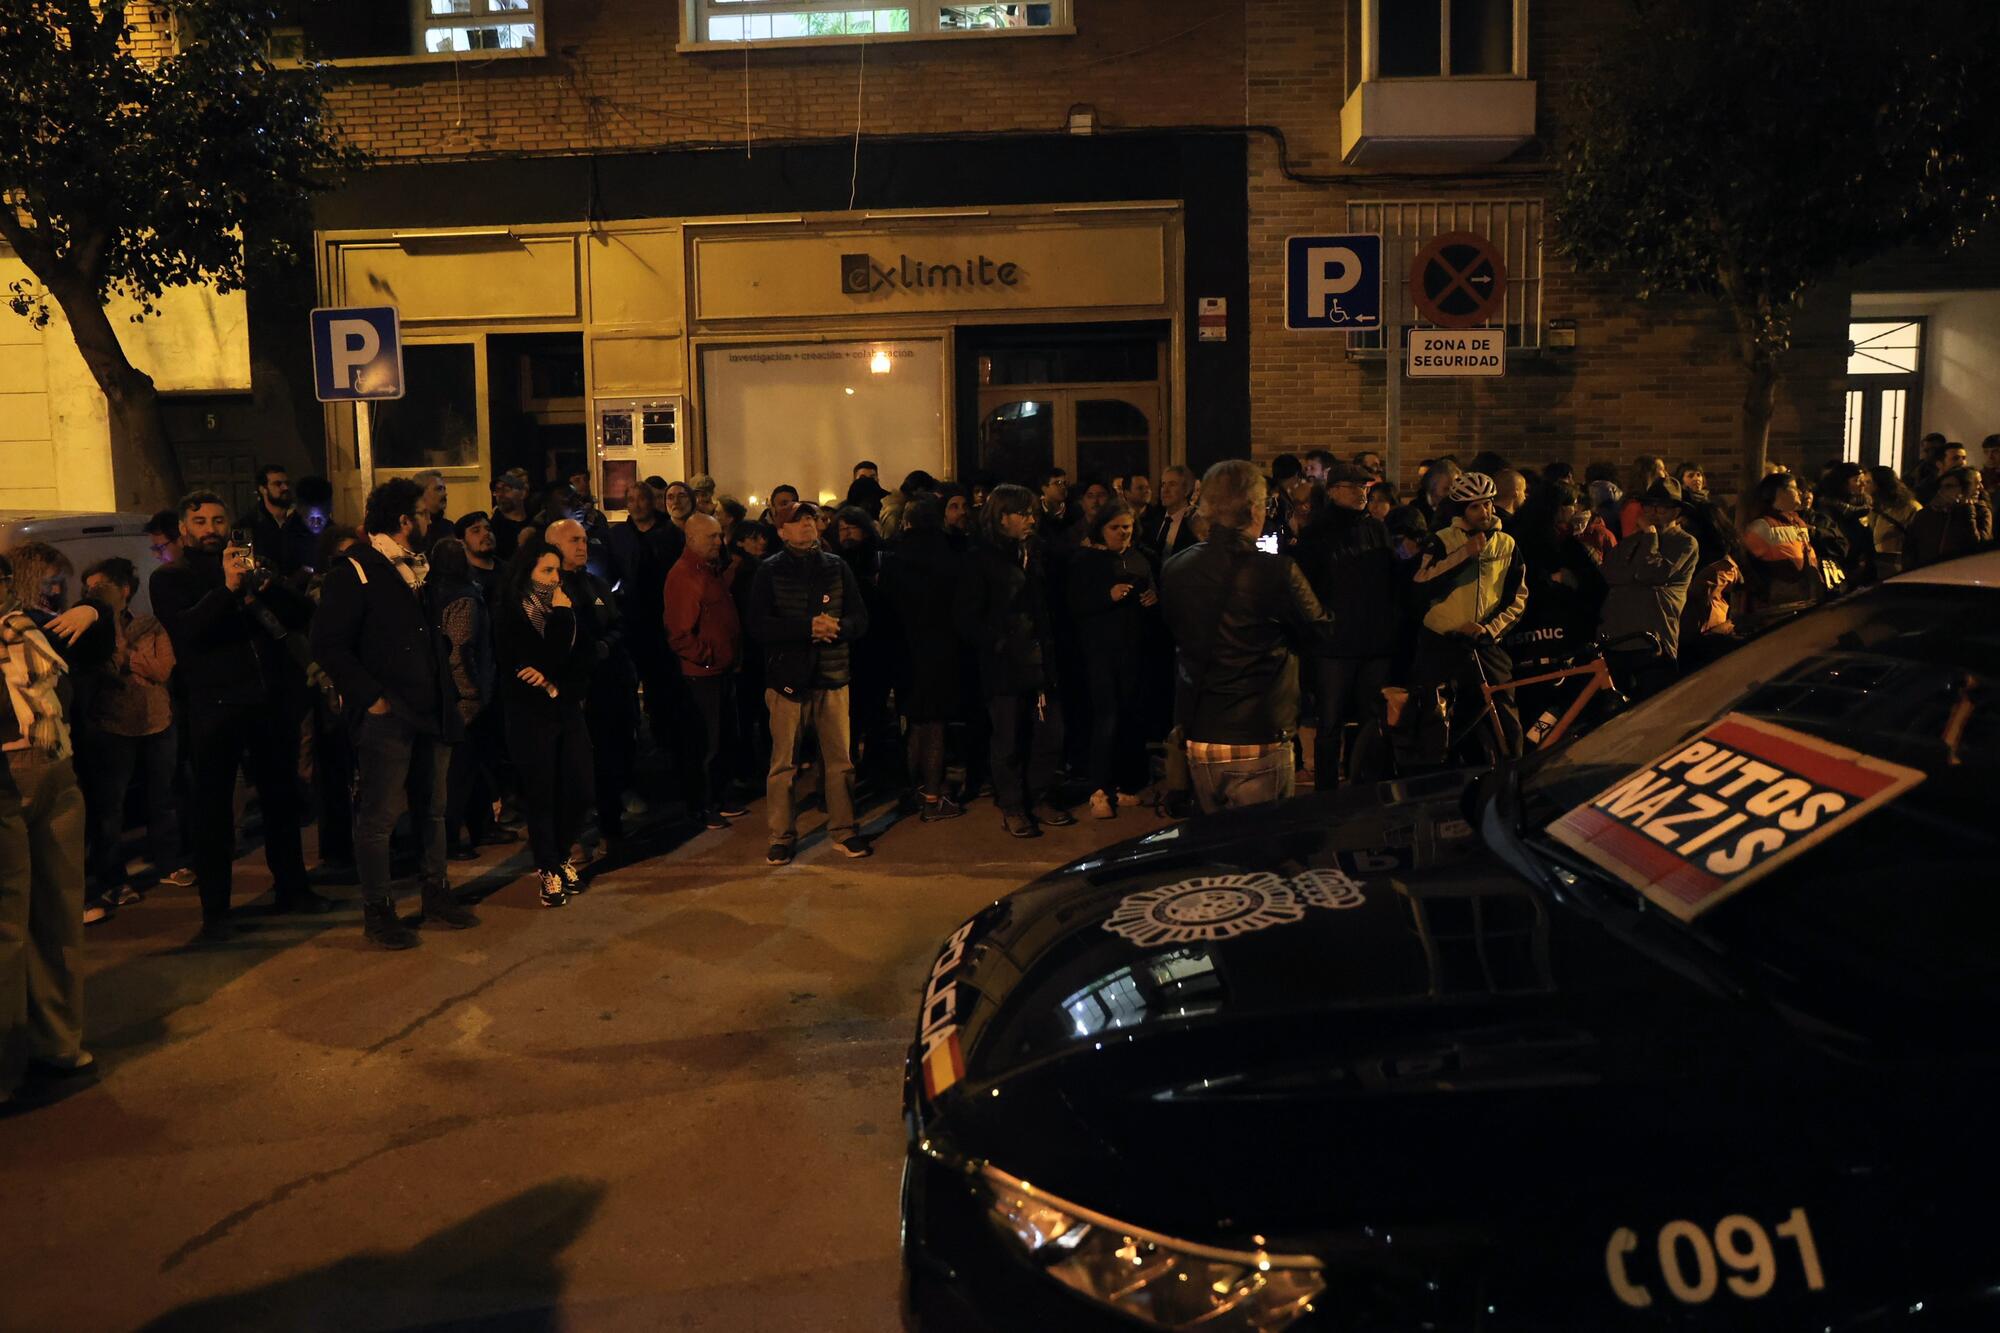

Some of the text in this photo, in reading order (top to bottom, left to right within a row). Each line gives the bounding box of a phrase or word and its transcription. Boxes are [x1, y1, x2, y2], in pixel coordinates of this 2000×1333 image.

[841, 254, 1020, 294] exlimite
[1307, 246, 1363, 318] P
[329, 318, 380, 389] P
[1414, 354, 1499, 367] SEGURIDAD
[1424, 339, 1490, 351] ZONA DE
[207, 414, 216, 430] 5
[1660, 740, 1847, 832] PUTOS
[1594, 770, 1787, 876] NAZIS
[1657, 1205, 1825, 1306] 091
